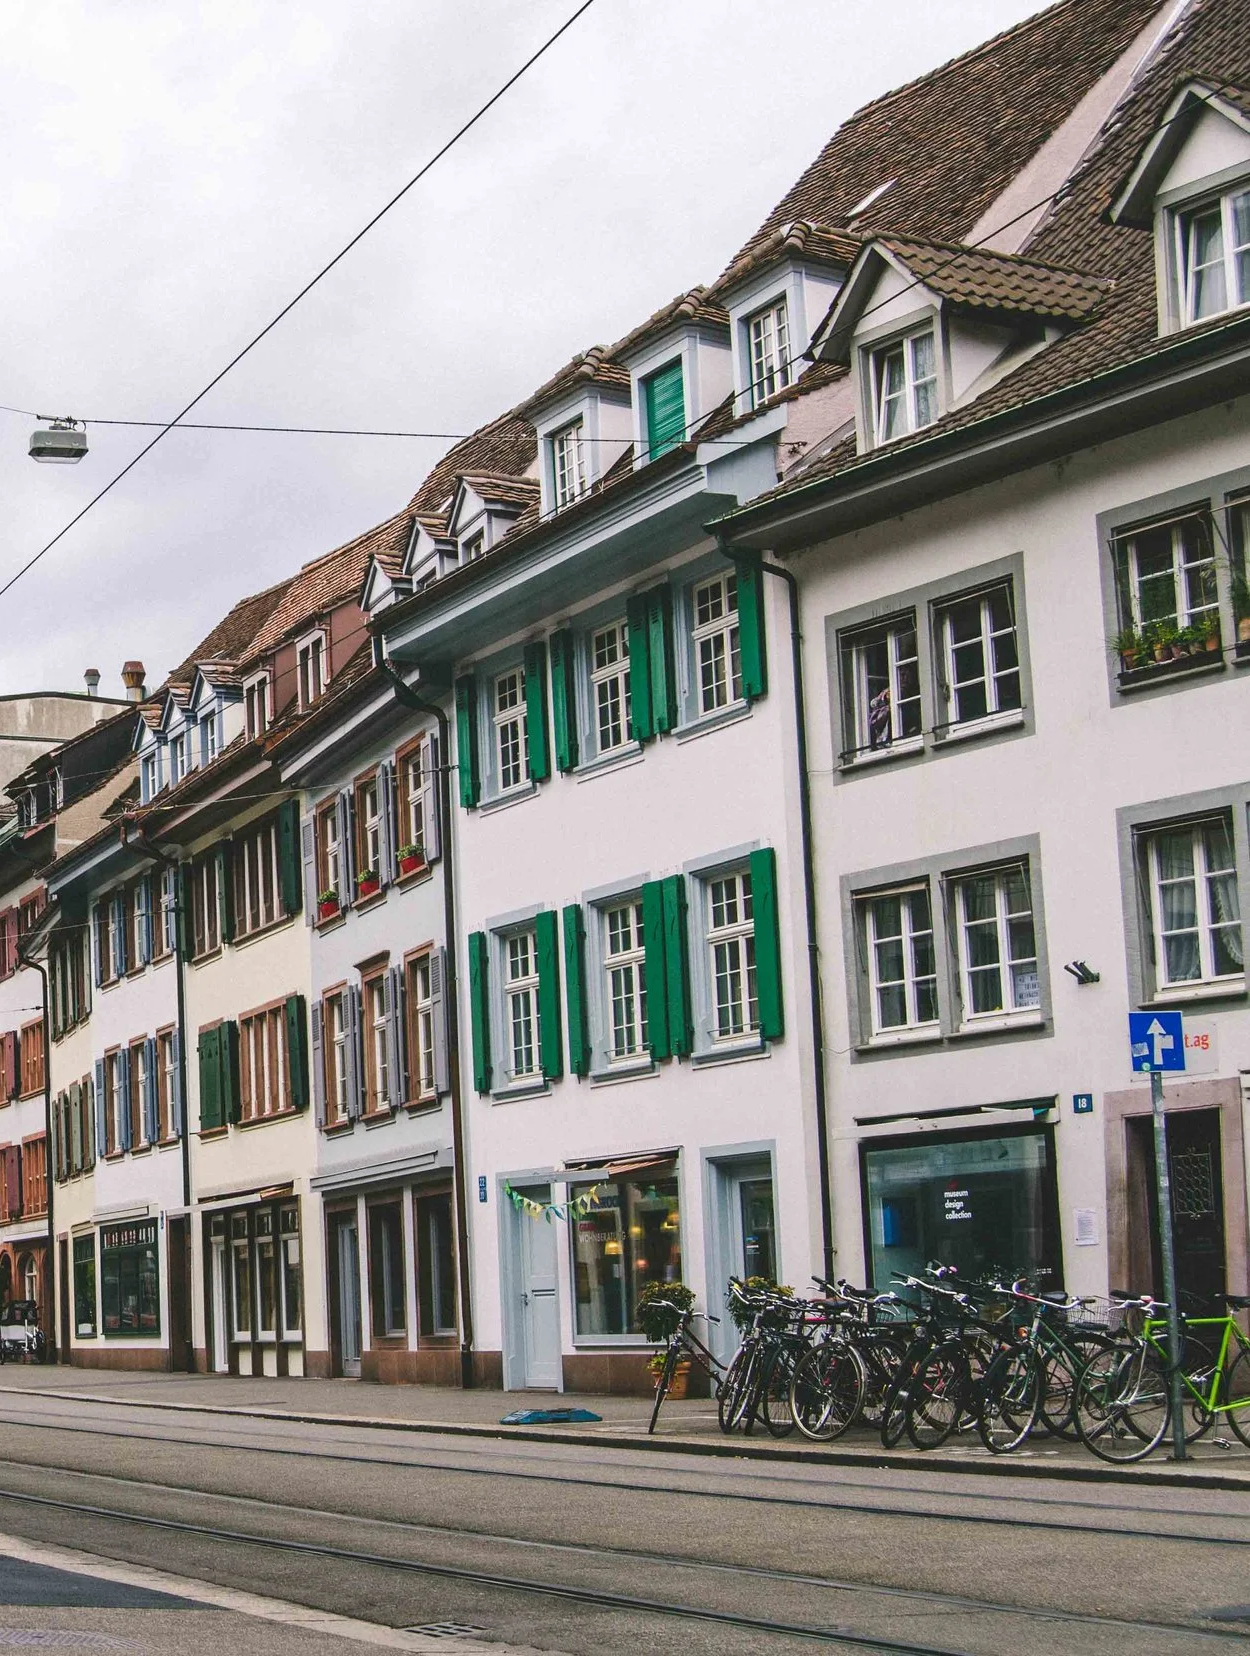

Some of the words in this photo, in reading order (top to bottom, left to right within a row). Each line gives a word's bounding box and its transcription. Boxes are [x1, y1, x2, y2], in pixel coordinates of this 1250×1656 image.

[1078, 1098, 1087, 1108] 18
[944, 1190, 969, 1198] museum
[945, 1199, 964, 1209] design
[945, 1210, 972, 1220] collection
